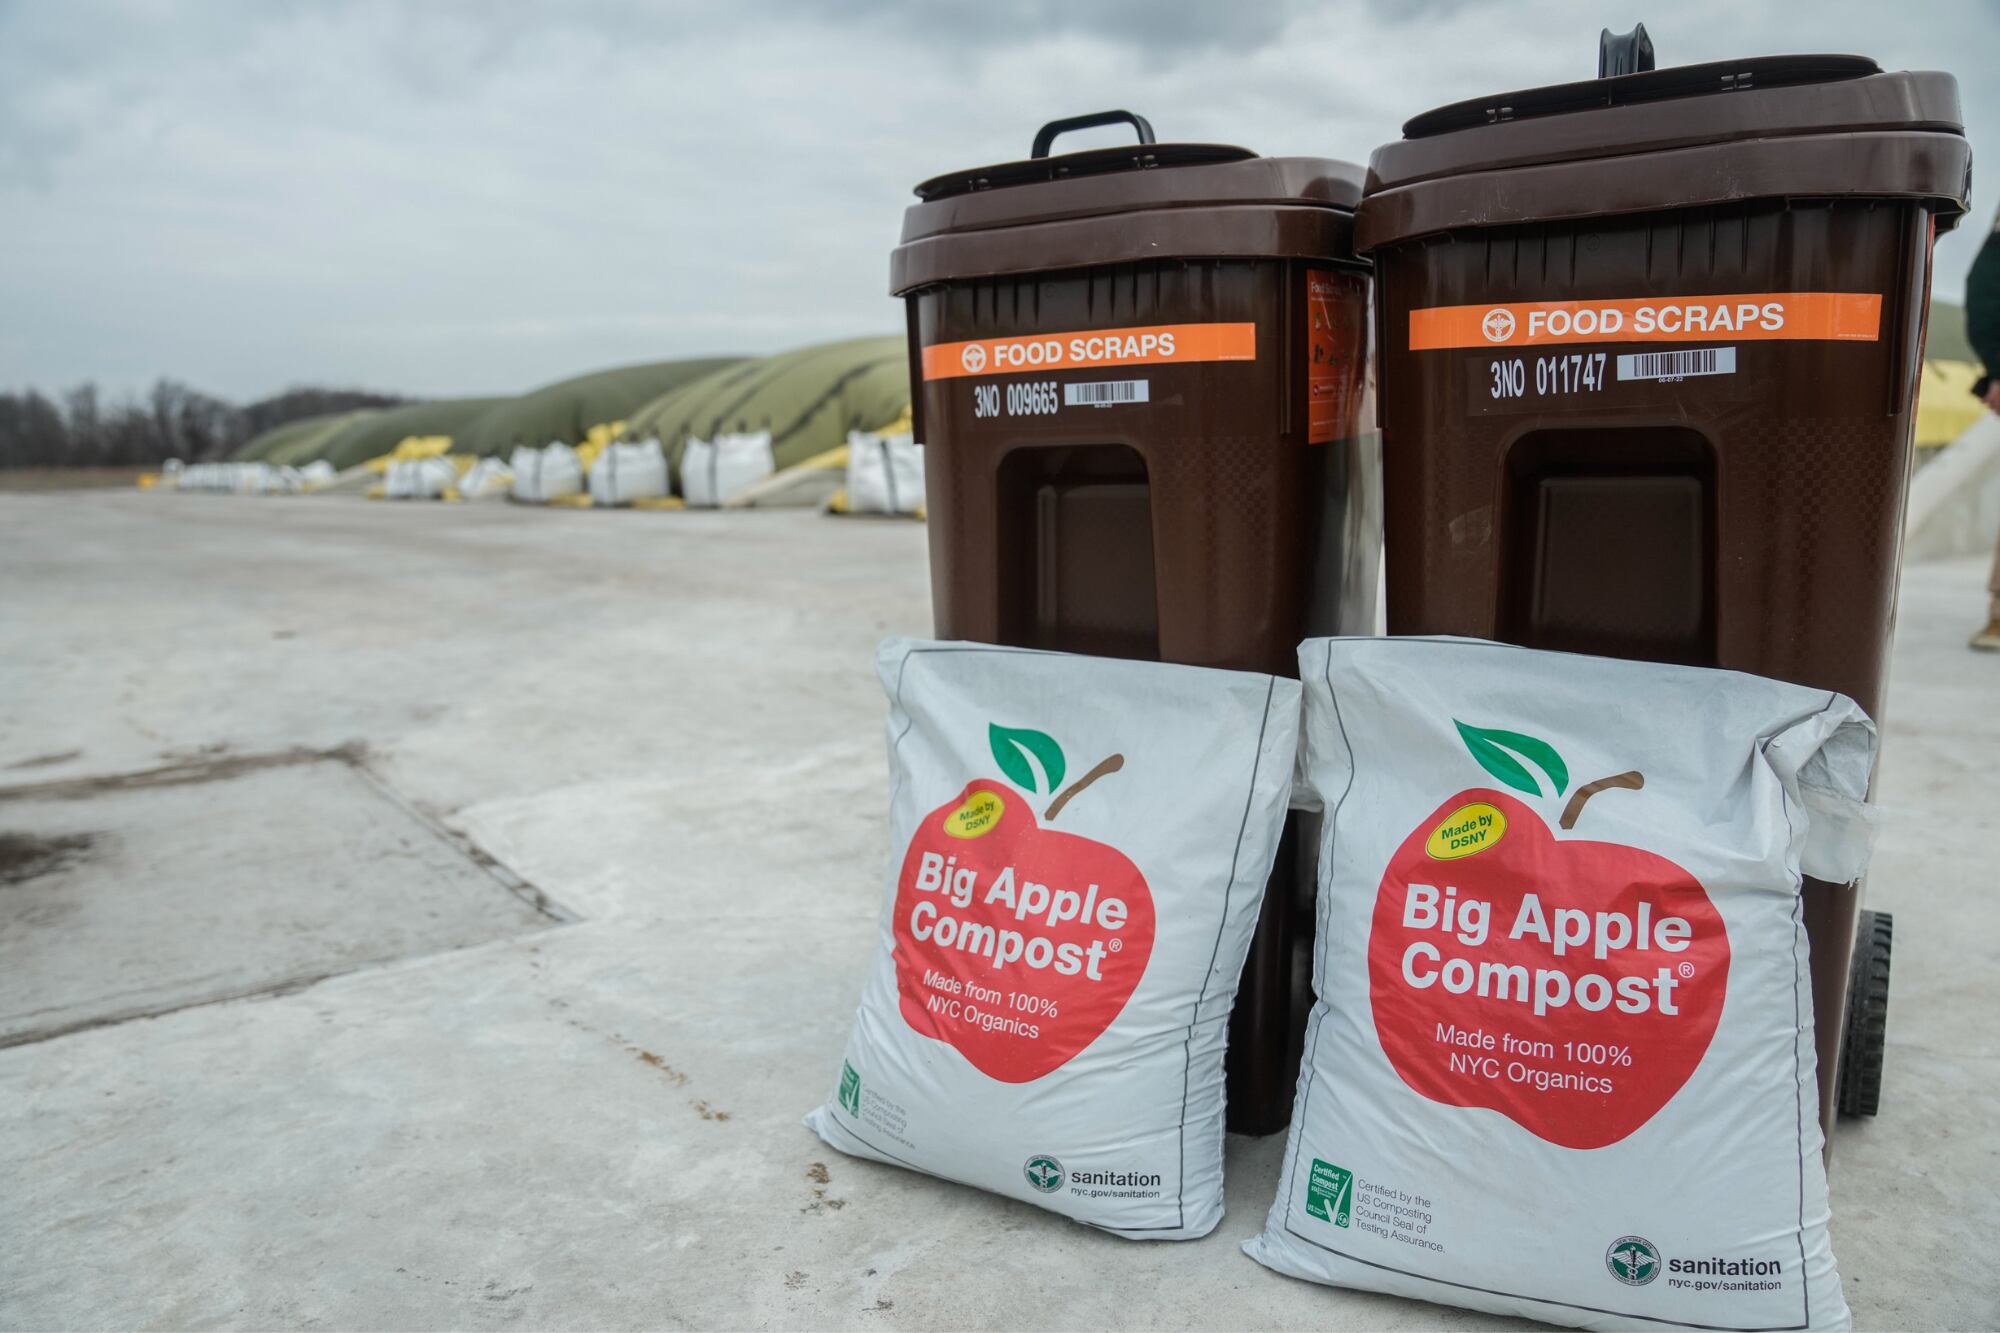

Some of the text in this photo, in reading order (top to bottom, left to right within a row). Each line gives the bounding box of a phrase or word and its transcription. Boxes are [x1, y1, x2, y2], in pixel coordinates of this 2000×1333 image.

[1528, 309, 1623, 337] FOOD
[1634, 303, 1784, 333] SCRAPS
[994, 340, 1063, 368] FOOD
[1069, 333, 1175, 362] SCRAPS
[1536, 353, 1607, 395] 011747
[1007, 381, 1058, 416] 009665
[959, 800, 995, 821] Made by
[965, 814, 991, 831] DSNY
[1441, 814, 1492, 840] Made by
[1451, 829, 1487, 850] DSNY
[915, 851, 1128, 930] Big Apple
[1402, 883, 1692, 960] Big Apple
[923, 969, 1058, 1018] Made from 100%
[927, 994, 1040, 1039] NYC Organics
[1436, 1023, 1632, 1067] Made from 100%
[1450, 1053, 1613, 1094] NYC Organics
[1070, 1187, 1160, 1198] nyc.gov/sanitation
[1071, 1170, 1161, 1187] sanitation
[1358, 1179, 1431, 1208] Certified by the
[1356, 1205, 1427, 1235] Council Seal of
[1357, 1192, 1370, 1205] US
[1373, 1197, 1432, 1224] Composting
[1355, 1217, 1446, 1253] Testing Assurance.
[1668, 1257, 1782, 1276] sanitation
[1668, 1278, 1782, 1291] nyc.gov/sanitation
